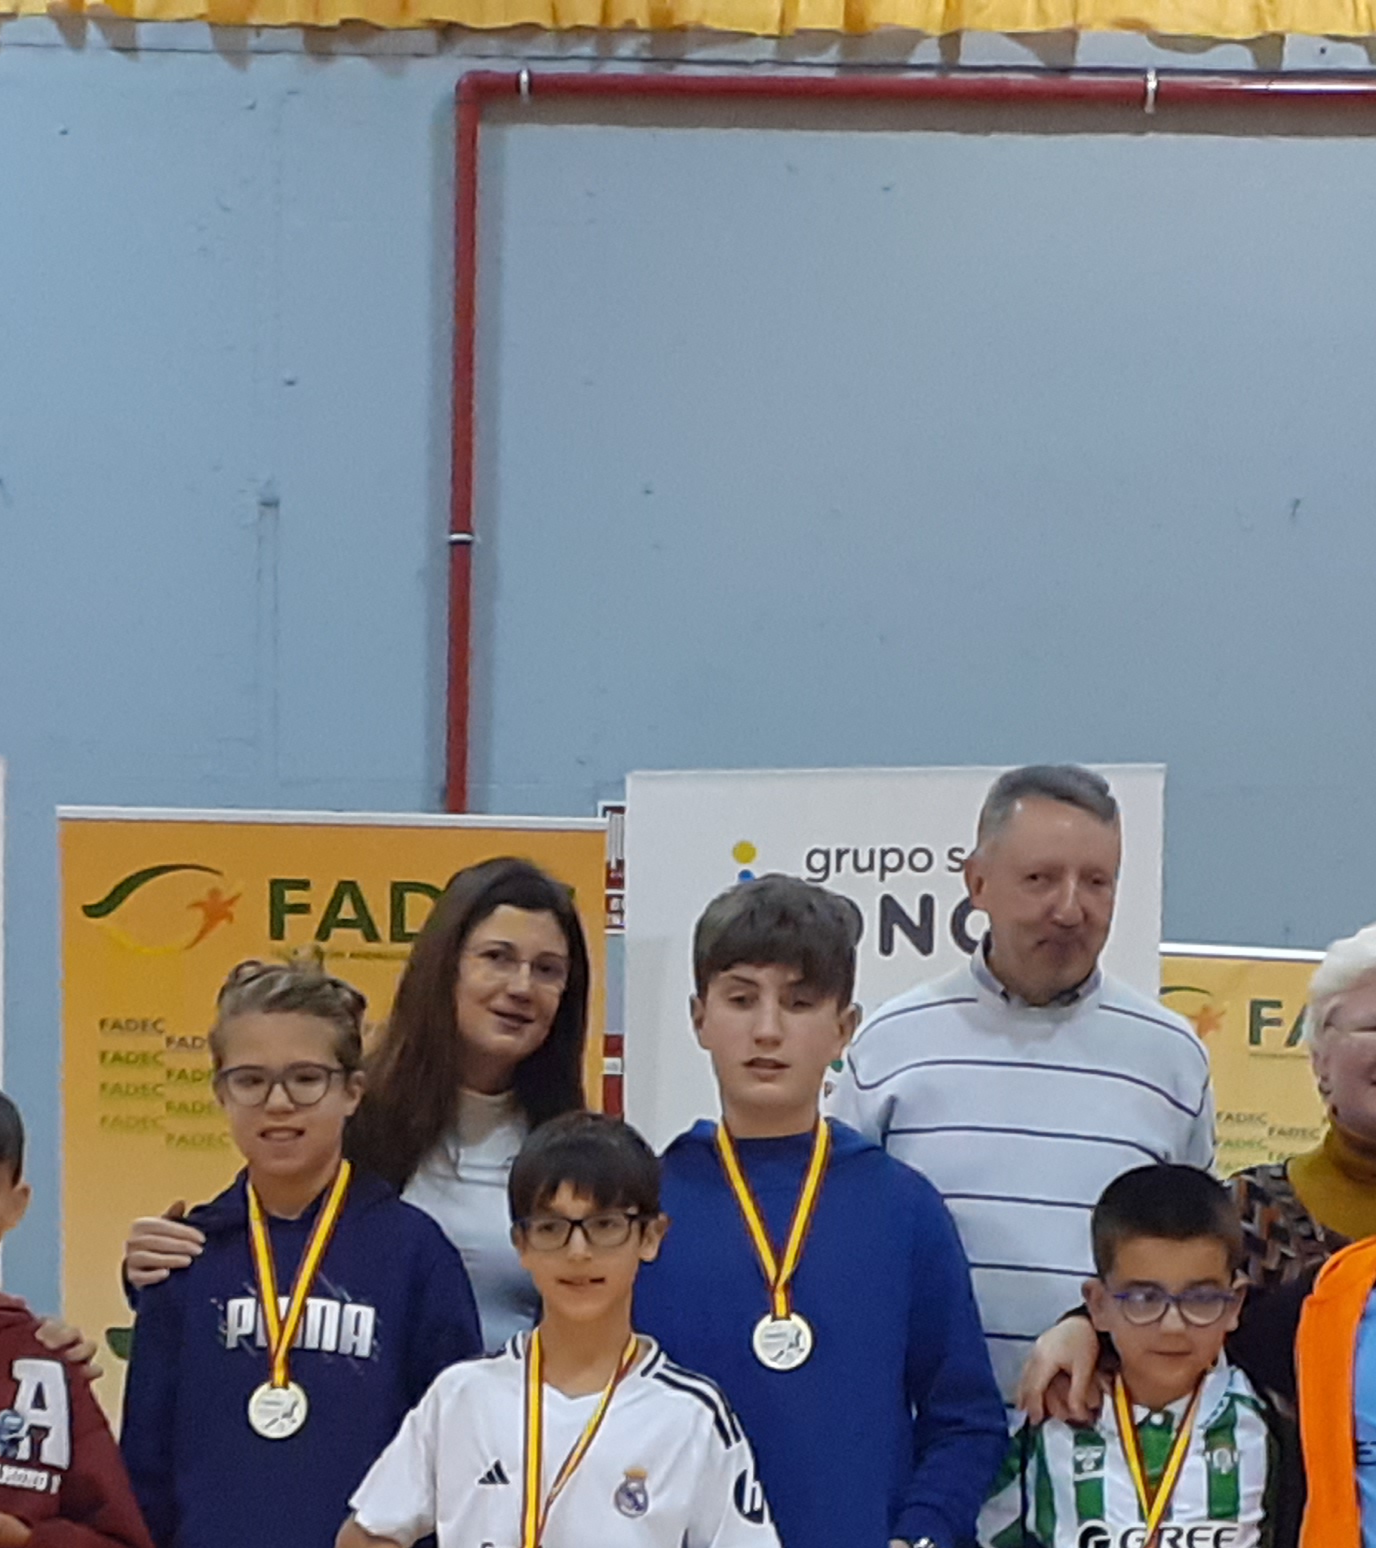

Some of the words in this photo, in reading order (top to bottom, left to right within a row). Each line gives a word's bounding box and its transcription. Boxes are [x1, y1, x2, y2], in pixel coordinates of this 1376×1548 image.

[805, 847, 934, 882] grupo
[269, 878, 444, 944] FAD
[98, 1017, 166, 1034] FADEC
[165, 1035, 207, 1050] FAD
[98, 1050, 165, 1067] FADEC
